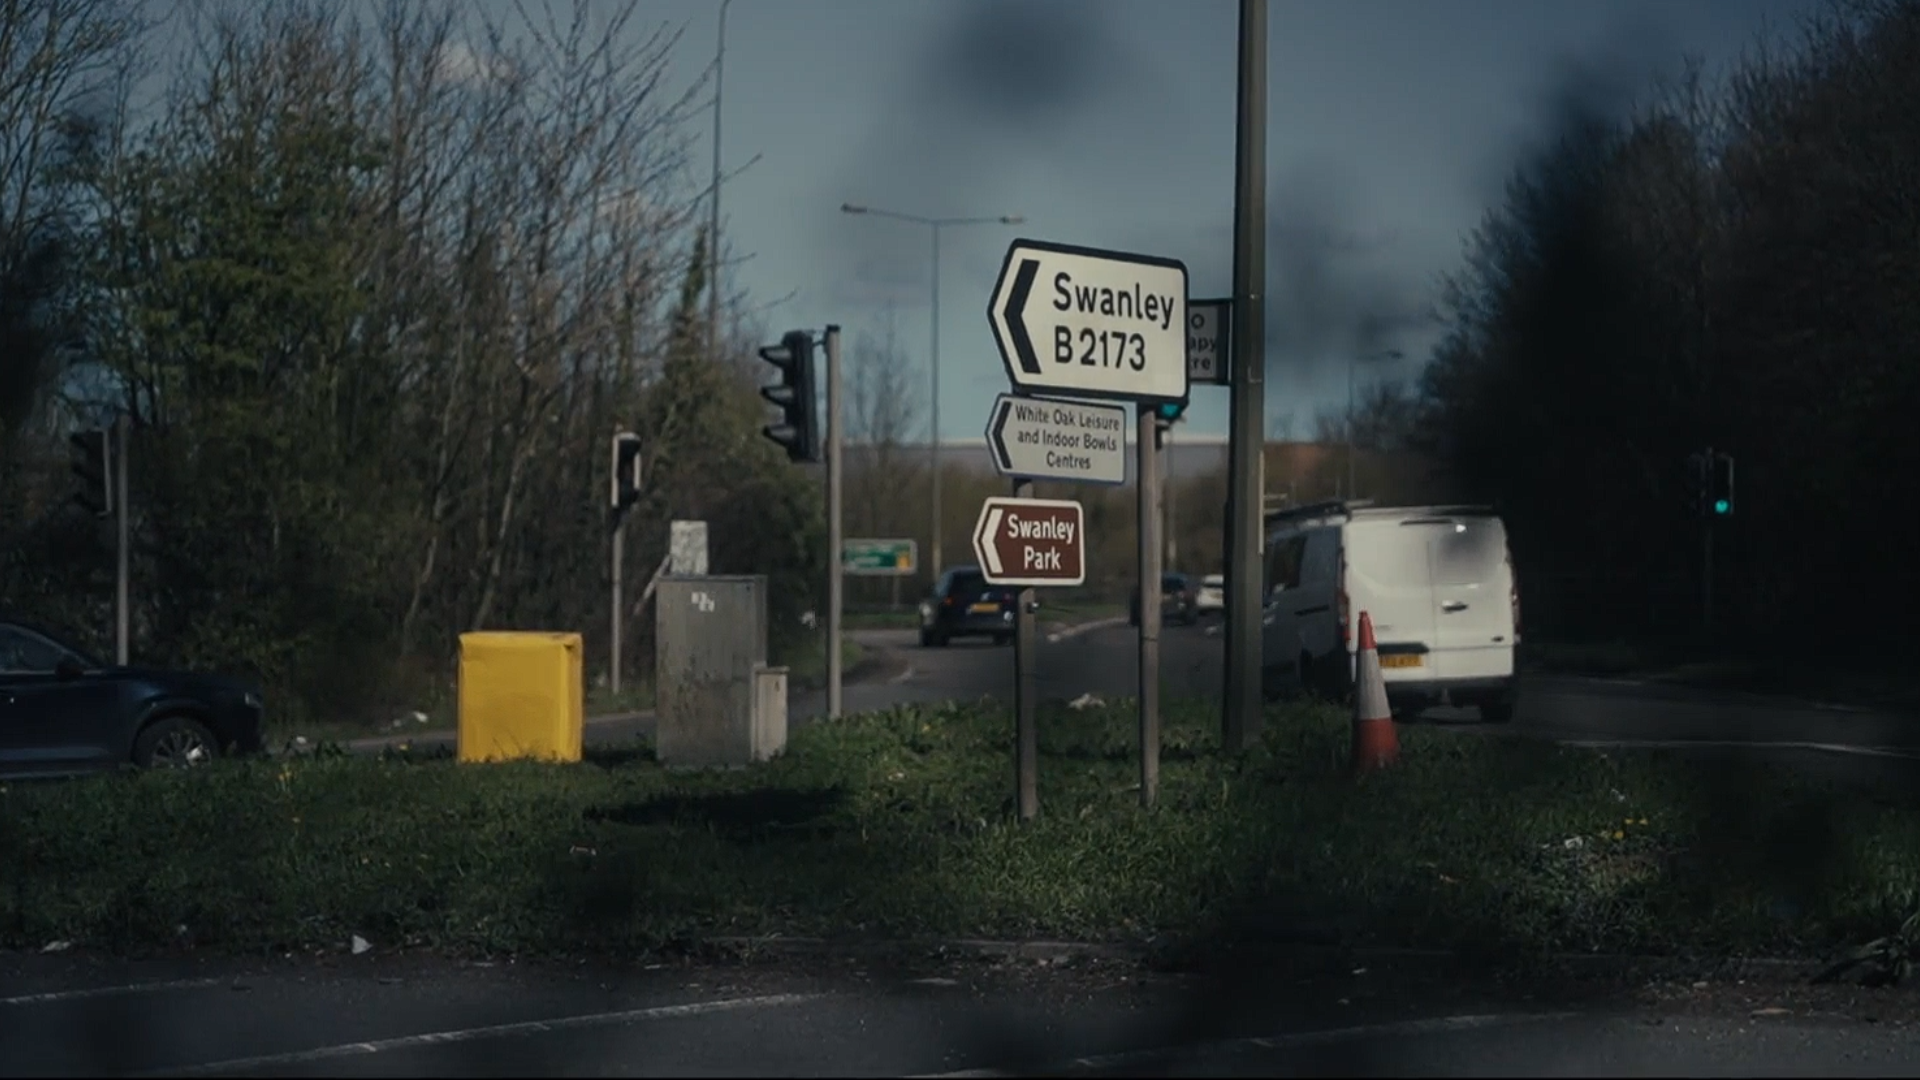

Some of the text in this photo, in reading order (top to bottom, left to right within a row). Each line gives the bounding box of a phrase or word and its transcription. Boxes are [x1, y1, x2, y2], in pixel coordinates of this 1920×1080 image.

[1053, 272, 1174, 330] Swanley
[1015, 405, 1120, 431] White Oak Leisure
[1017, 429, 1117, 451] and Indoor Bowls
[1046, 450, 1091, 469] Centres
[1008, 514, 1075, 545] Swanley
[1023, 545, 1062, 571] Park
